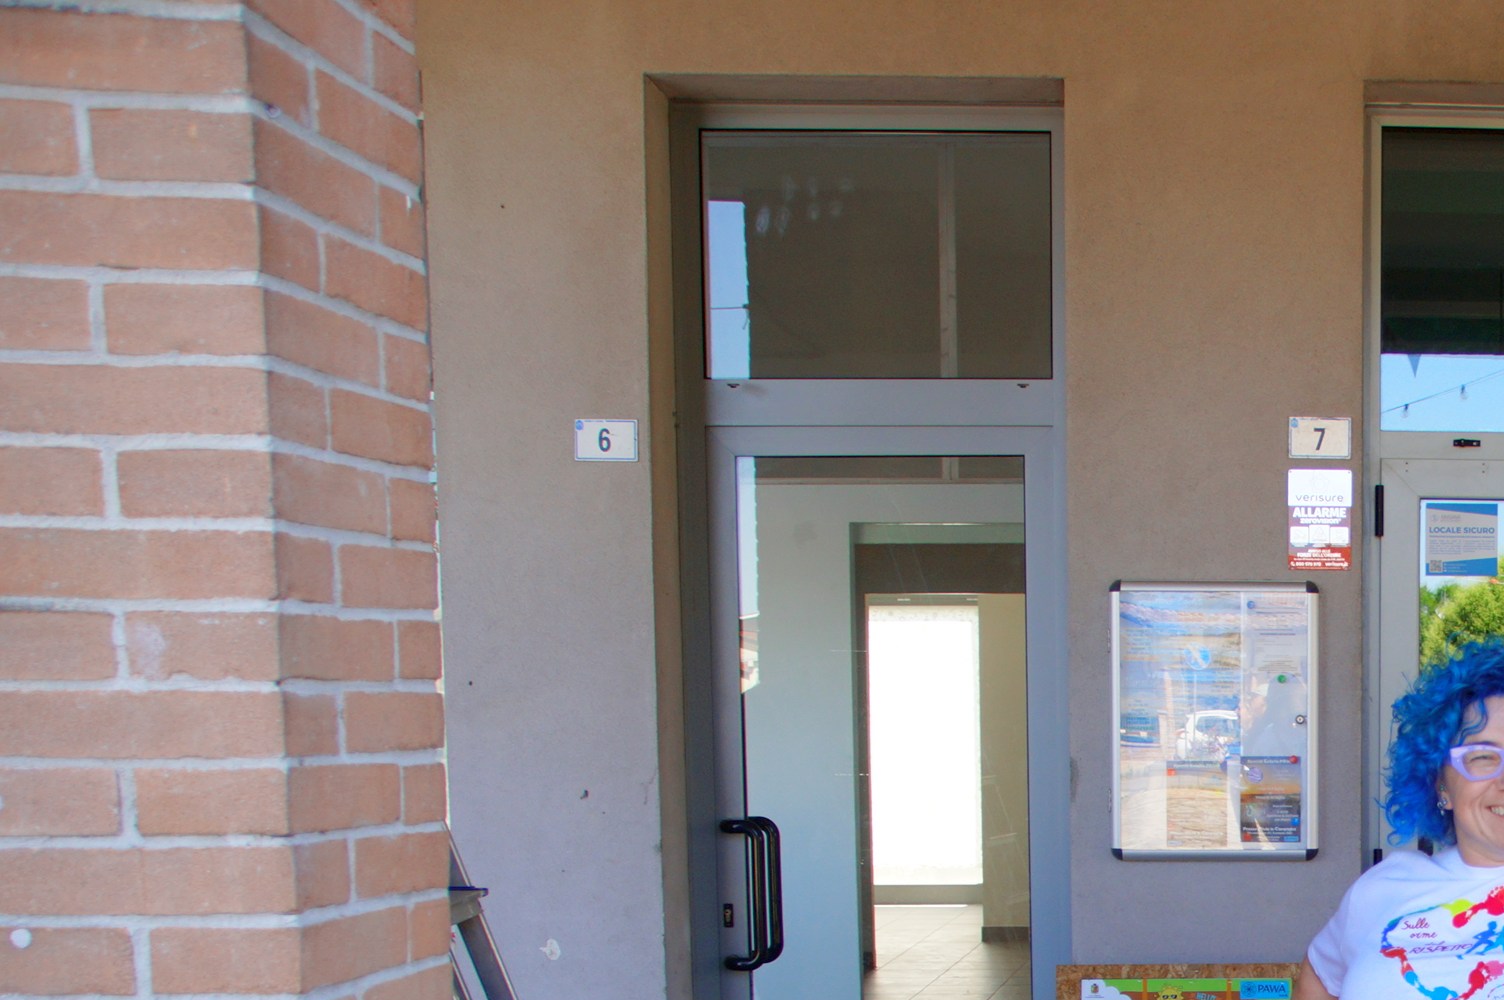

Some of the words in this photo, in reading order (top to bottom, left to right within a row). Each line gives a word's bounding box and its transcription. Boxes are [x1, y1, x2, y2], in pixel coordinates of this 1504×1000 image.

[598, 427, 611, 452] 6
[1313, 427, 1326, 451] 7
[1295, 494, 1344, 503] verisure
[1292, 507, 1347, 518] ALLARME
[1401, 917, 1430, 930] Sulle
[1257, 984, 1286, 993] PAWA
